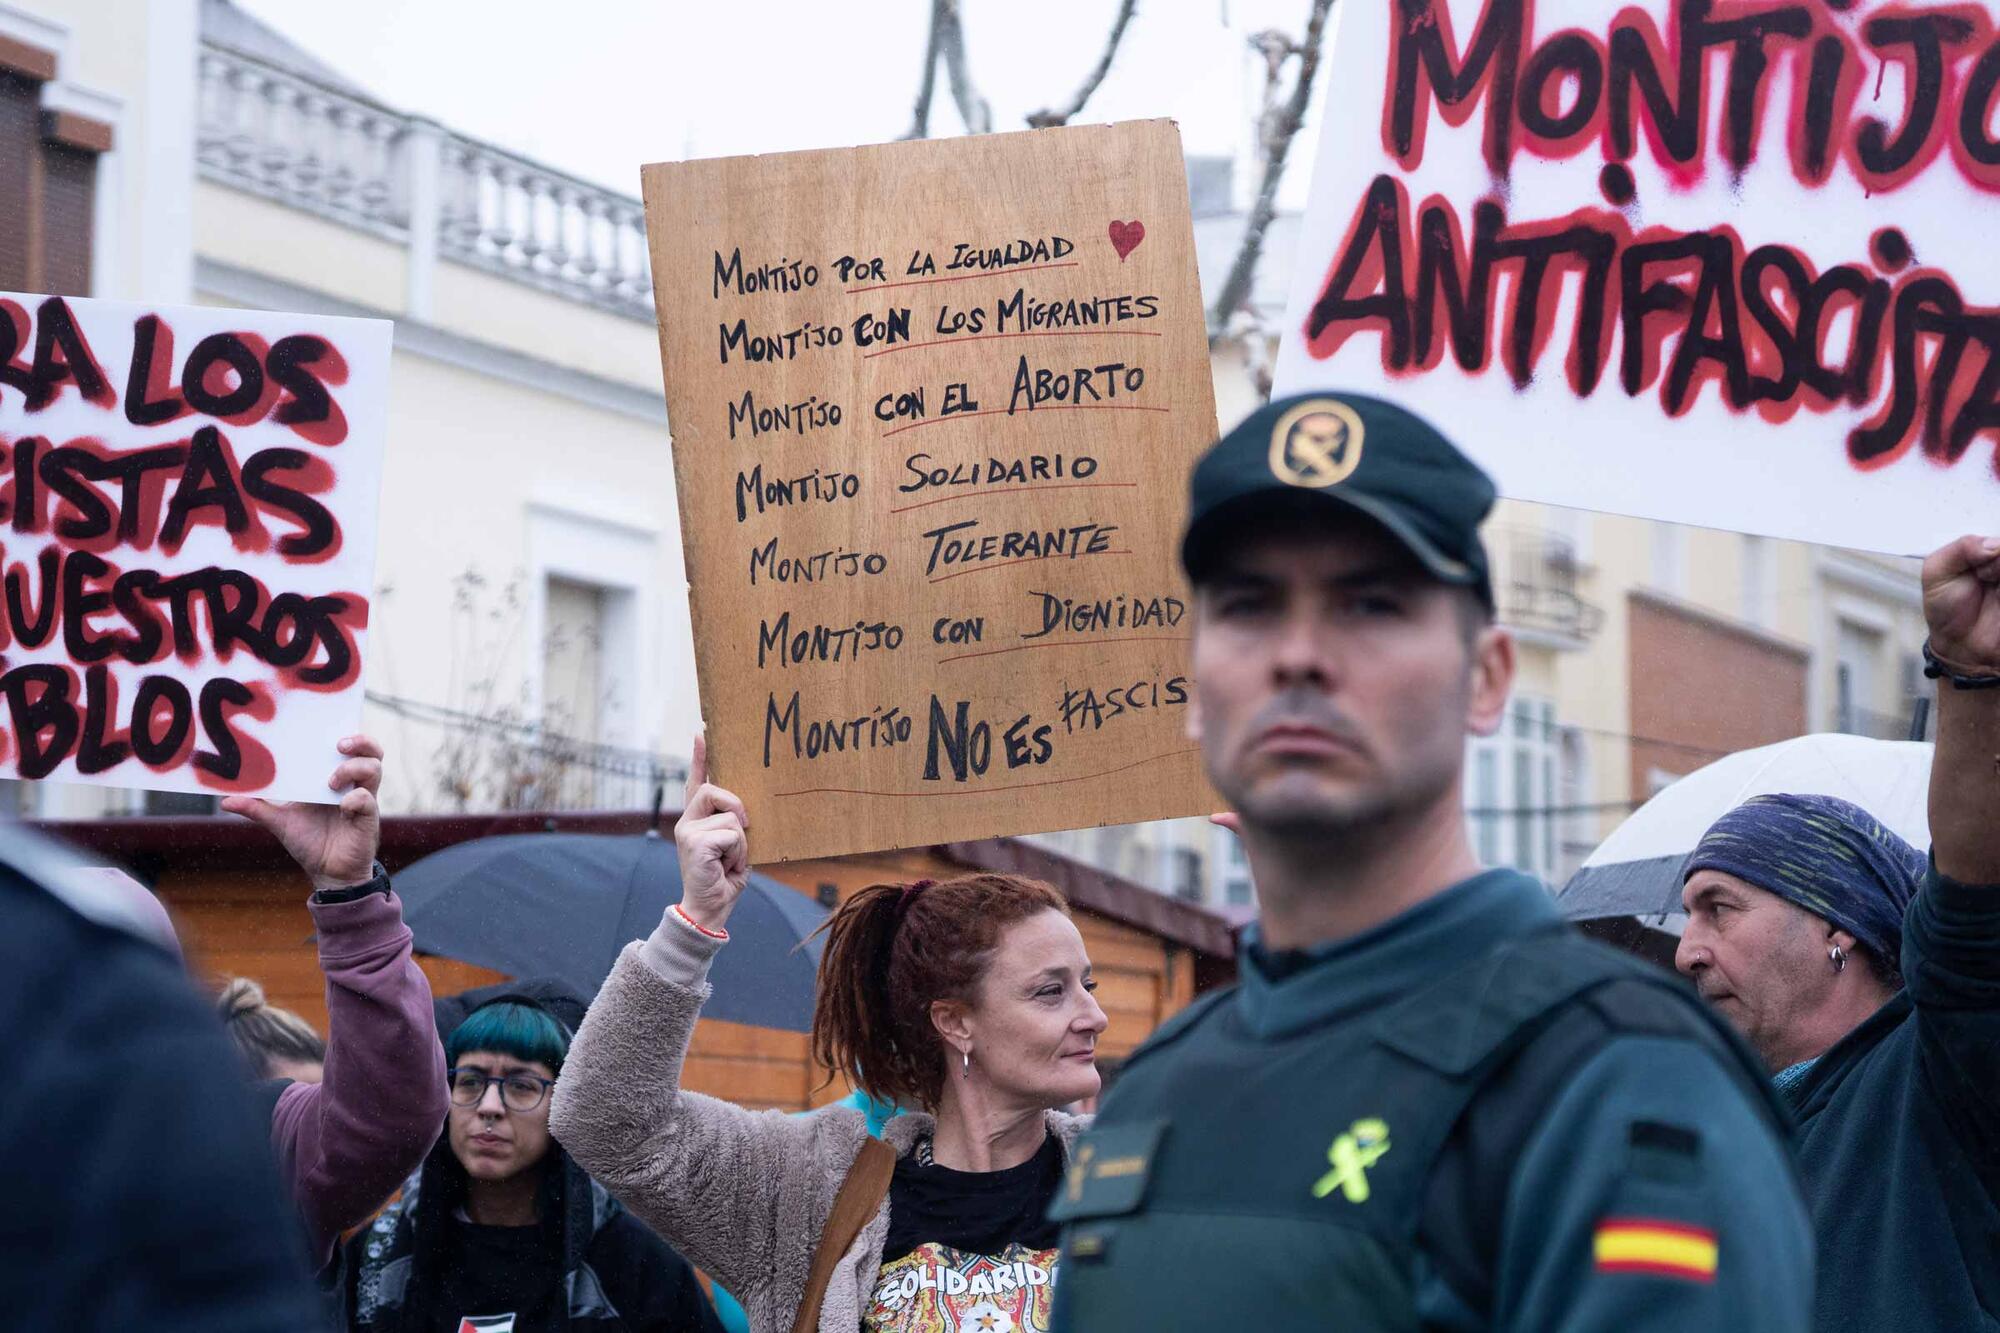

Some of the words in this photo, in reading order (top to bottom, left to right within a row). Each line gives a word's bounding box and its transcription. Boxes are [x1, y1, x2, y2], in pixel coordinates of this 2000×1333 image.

[832, 255, 887, 283] POR
[906, 249, 936, 276] LA
[946, 235, 1075, 270] IGUALDAD
[852, 307, 911, 347] CON
[936, 305, 986, 335] LOS
[997, 288, 1159, 333] MIGRANTES
[124, 313, 350, 446] LOS
[874, 386, 925, 421] CON
[941, 382, 978, 413] EL
[1007, 354, 1145, 416] ABORTO
[0, 425, 338, 564] ISTAS
[899, 453, 1098, 493] SOLIDARIO
[923, 519, 1119, 576] TOLERANTE
[0, 545, 368, 693] UESTROS
[933, 616, 984, 643] CON
[1021, 590, 1185, 638] DIGNIDAD
[0, 655, 277, 793] BLOS
[922, 693, 991, 782] NO
[1002, 714, 1053, 769] ES
[1058, 676, 1190, 735] FASCIS
[879, 1261, 1058, 1307] SOLIDARID
